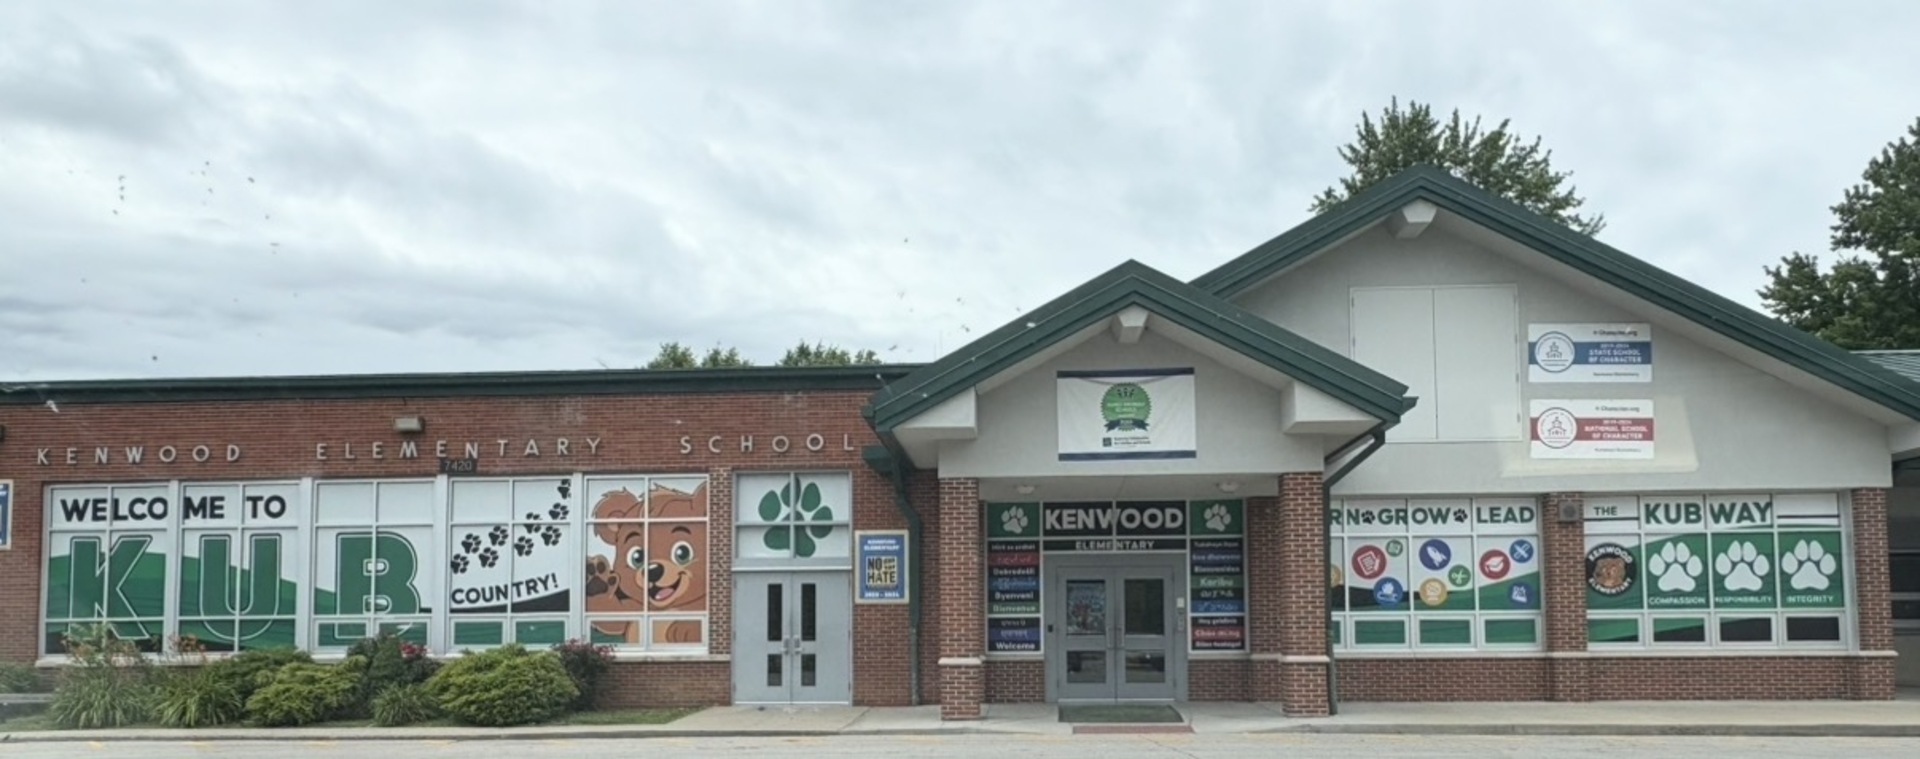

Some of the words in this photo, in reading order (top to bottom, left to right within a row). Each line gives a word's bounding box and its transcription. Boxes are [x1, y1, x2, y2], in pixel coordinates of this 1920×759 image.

[37, 444, 242, 465] KENWOOD
[316, 437, 602, 460] ELEMENTARY
[680, 433, 854, 455] SCHOOL
[444, 460, 472, 471] 7420
[60, 495, 225, 522] WELCOME
[246, 495, 287, 519] TO
[1593, 506, 1618, 516] THE
[1045, 508, 1183, 531] KENWOOD
[1377, 507, 1452, 525] GROW
[1476, 506, 1535, 524] LEAD
[1075, 540, 1154, 550] ELEMENTARY
[1588, 546, 1633, 564] KENWOOD
[867, 557, 883, 571] NO
[867, 571, 896, 583] HATE
[1200, 577, 1234, 587] Karibu
[68, 532, 421, 641] KUB
[451, 572, 558, 605] COUNTRY!
[1588, 577, 1632, 594] ELEMENTARY
[1648, 596, 1707, 605] COMPASSION
[1714, 595, 1773, 603] RESPONSIBILITY
[1786, 595, 1834, 603] INTEGRITY
[996, 641, 1036, 650] Welcome
